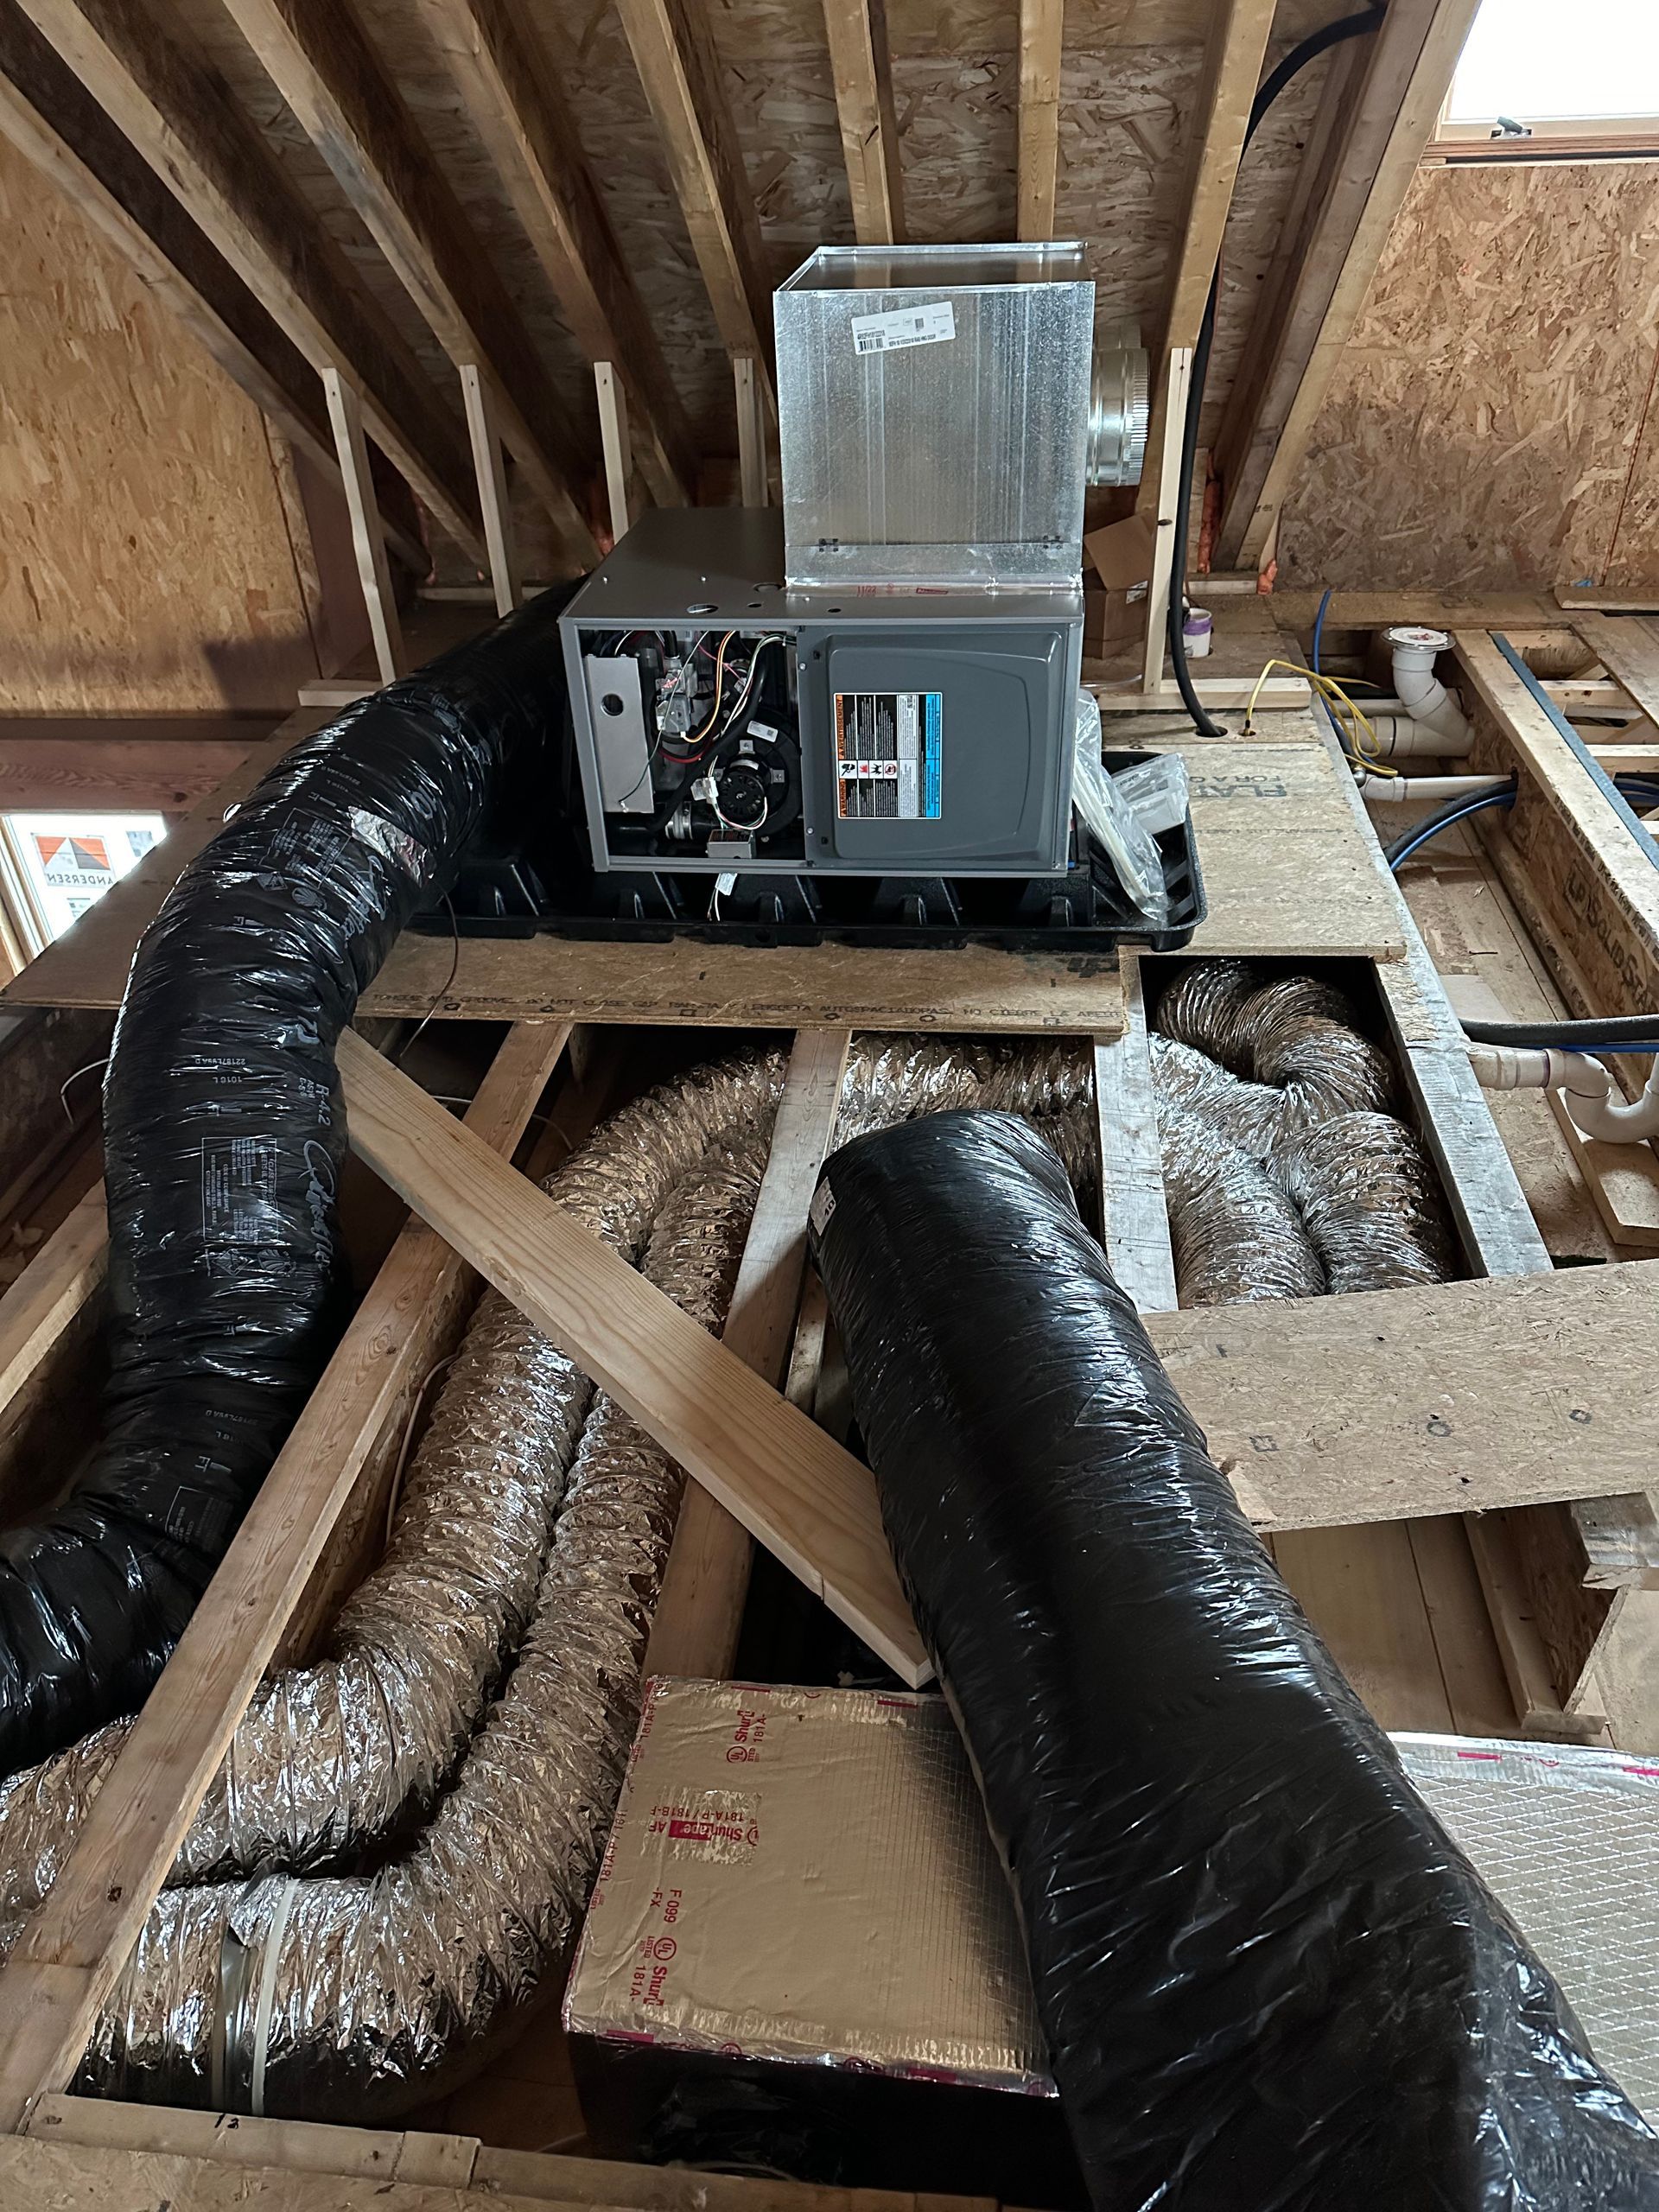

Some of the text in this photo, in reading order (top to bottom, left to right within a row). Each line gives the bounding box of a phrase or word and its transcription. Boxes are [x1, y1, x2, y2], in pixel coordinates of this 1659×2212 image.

[315, 1084, 331, 1126] R-4.2
[702, 1809, 745, 1822] 181A-P
[648, 1821, 667, 1833] AF
[683, 1822, 743, 1841] Shurtape
[664, 1900, 679, 1923] 099
[644, 1936, 655, 1959] LISTED
